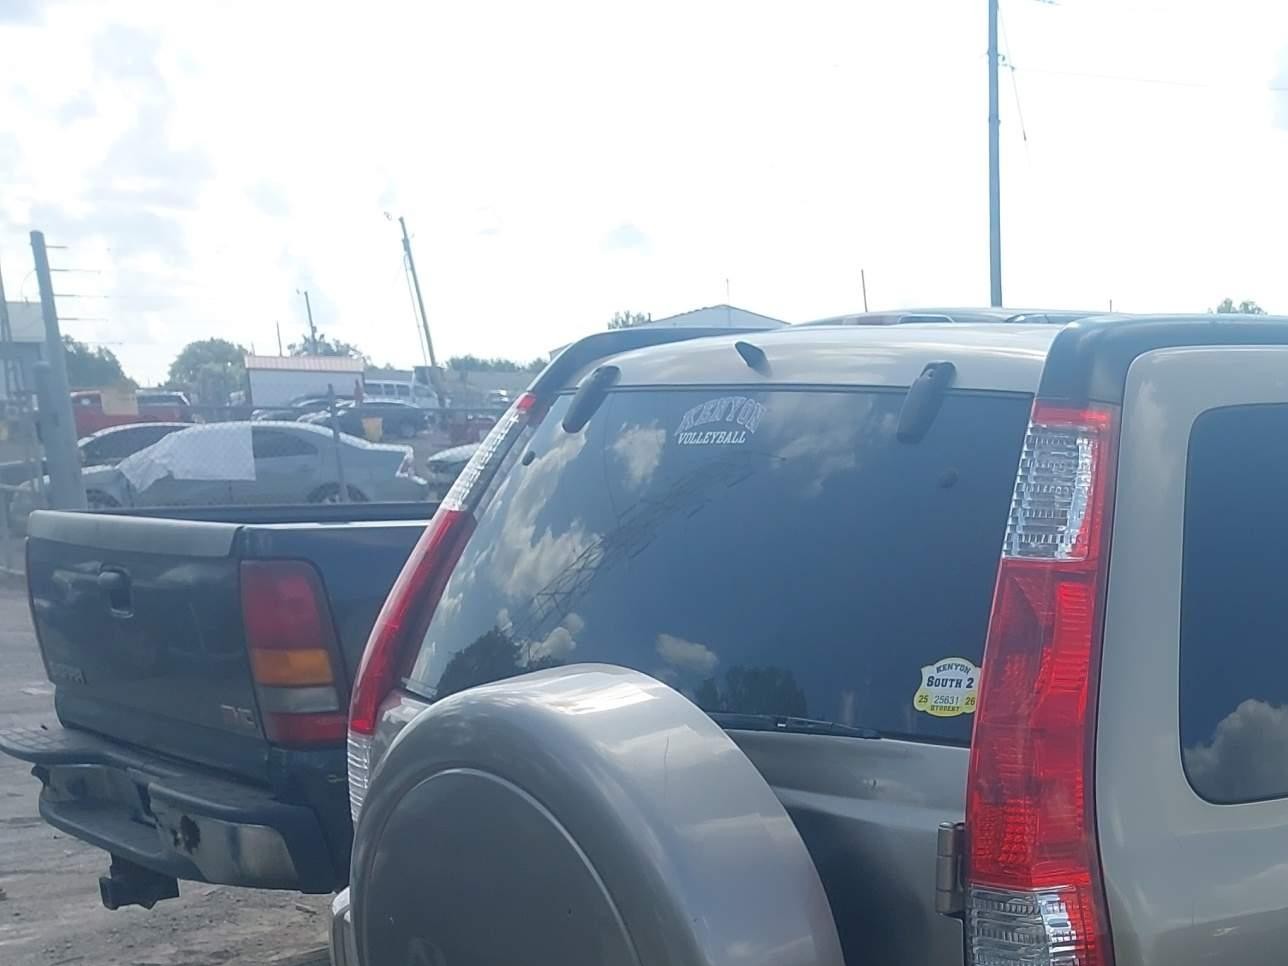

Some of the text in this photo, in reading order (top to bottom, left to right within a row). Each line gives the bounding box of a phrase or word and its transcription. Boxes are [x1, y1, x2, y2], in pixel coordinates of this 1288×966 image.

[674, 396, 767, 436] KENYON
[678, 431, 746, 445] VOLLEYBALL
[936, 663, 971, 675] KENYON
[966, 677, 974, 689] 2
[918, 694, 976, 706] 25 25631 26
